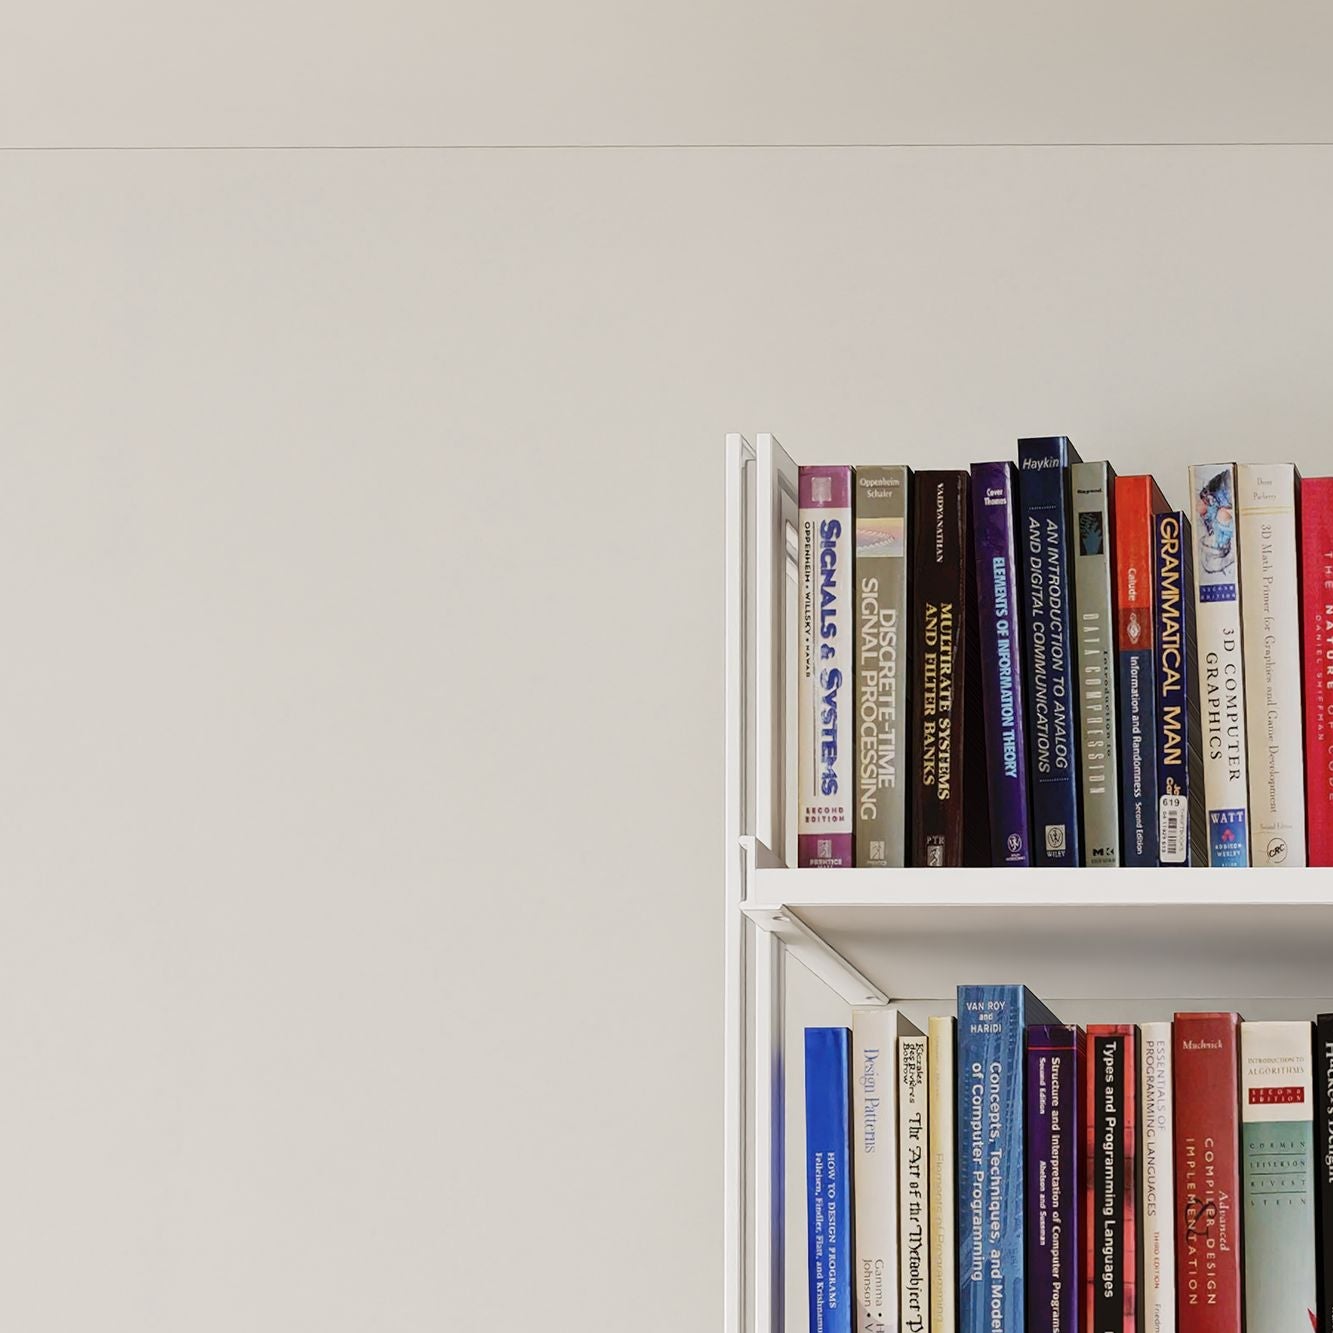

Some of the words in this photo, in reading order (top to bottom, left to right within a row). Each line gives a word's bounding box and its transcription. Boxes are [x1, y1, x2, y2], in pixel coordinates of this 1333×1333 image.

[860, 478, 900, 488] Oppenheim
[1022, 457, 1060, 470] Haykin
[1028, 516, 1040, 546] AND
[1046, 519, 1058, 536] AN
[820, 520, 842, 640] SIGNALS
[993, 557, 1008, 617] ELEMENTS
[1030, 550, 1044, 616] DIGITAL
[1047, 541, 1065, 670] INTRODUCTION
[1160, 518, 1181, 697] GRAMMATICAL
[820, 643, 836, 660] &
[861, 578, 878, 665] SIGNAL
[925, 603, 937, 646] AND
[996, 619, 1008, 636] OF
[1222, 628, 1236, 652] 3D
[924, 652, 936, 716] FILTER
[939, 603, 952, 712] MULTIRATE
[998, 639, 1013, 727] INFORMATION
[1053, 676, 1064, 694] TO
[878, 609, 896, 788] DISCRETE-TIME
[1032, 620, 1050, 772] COMMUNICATIONS
[1206, 652, 1222, 760] GRAPHICS
[1224, 664, 1241, 782] COMPUTER
[820, 668, 842, 796] SYSTEMS
[860, 671, 877, 820] PROCESSING
[923, 722, 936, 786] BANKS
[938, 718, 950, 800] SYSTEMS
[1002, 729, 1018, 779] THEORY
[1053, 698, 1068, 769] ANALOG
[1163, 706, 1182, 766] MAN
[1210, 811, 1244, 824] WATT
[966, 1002, 984, 1012] VAN
[988, 1001, 1005, 1012] ROY
[972, 1063, 984, 1077] of
[1103, 1041, 1116, 1083] Types
[971, 1080, 984, 1167] Computer
[1104, 1088, 1116, 1112] and
[1103, 1118, 1116, 1216] Programming
[971, 1172, 984, 1282] Programming
[1102, 1220, 1117, 1298] Languages
